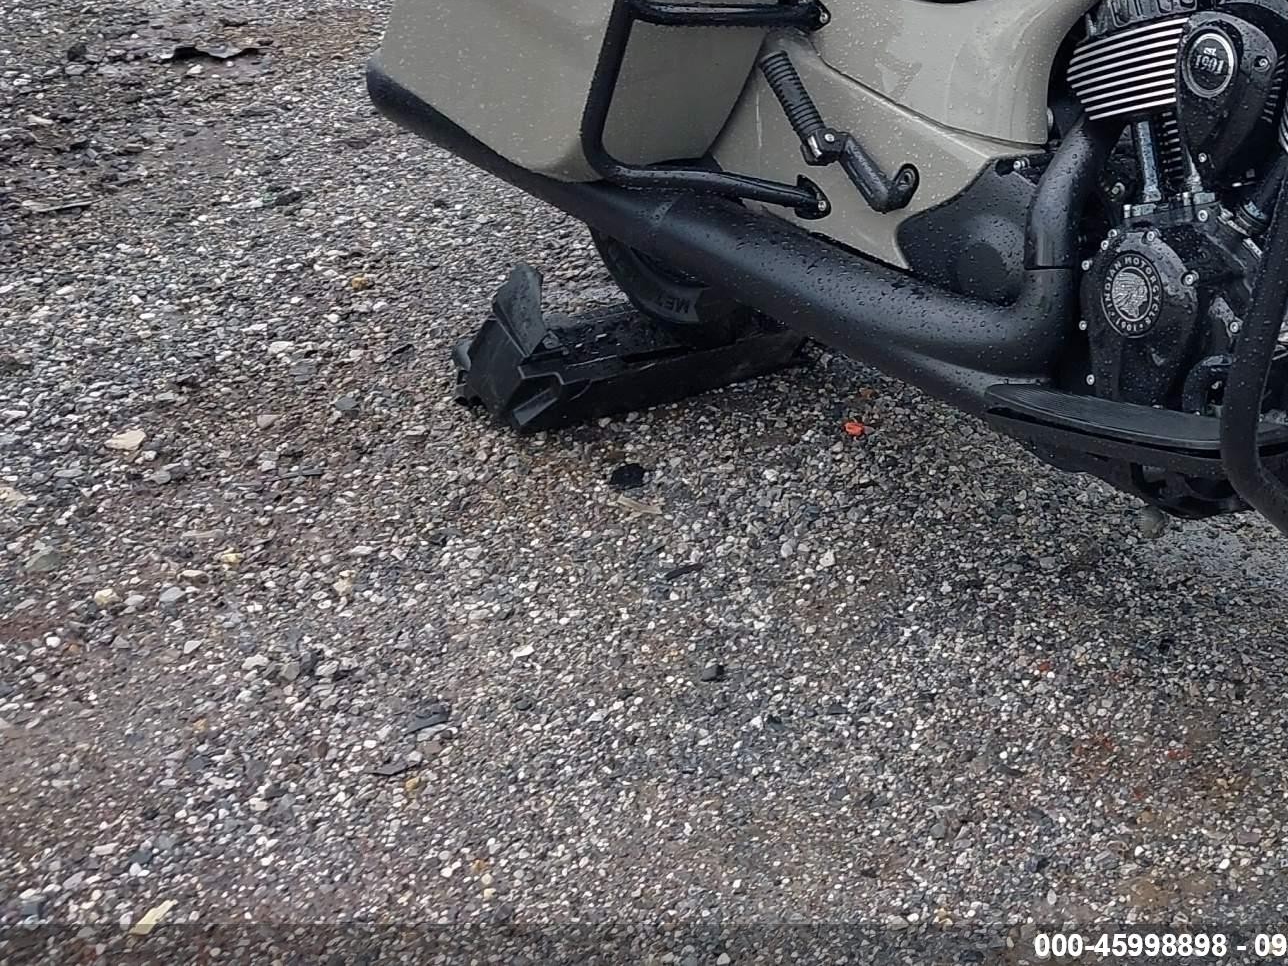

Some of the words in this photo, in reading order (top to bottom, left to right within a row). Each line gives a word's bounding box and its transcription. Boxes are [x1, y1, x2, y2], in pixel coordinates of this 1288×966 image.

[1194, 54, 1224, 75] 1901
[1103, 260, 1122, 309] INDIAN
[1123, 255, 1162, 326] MOTORCYCLE
